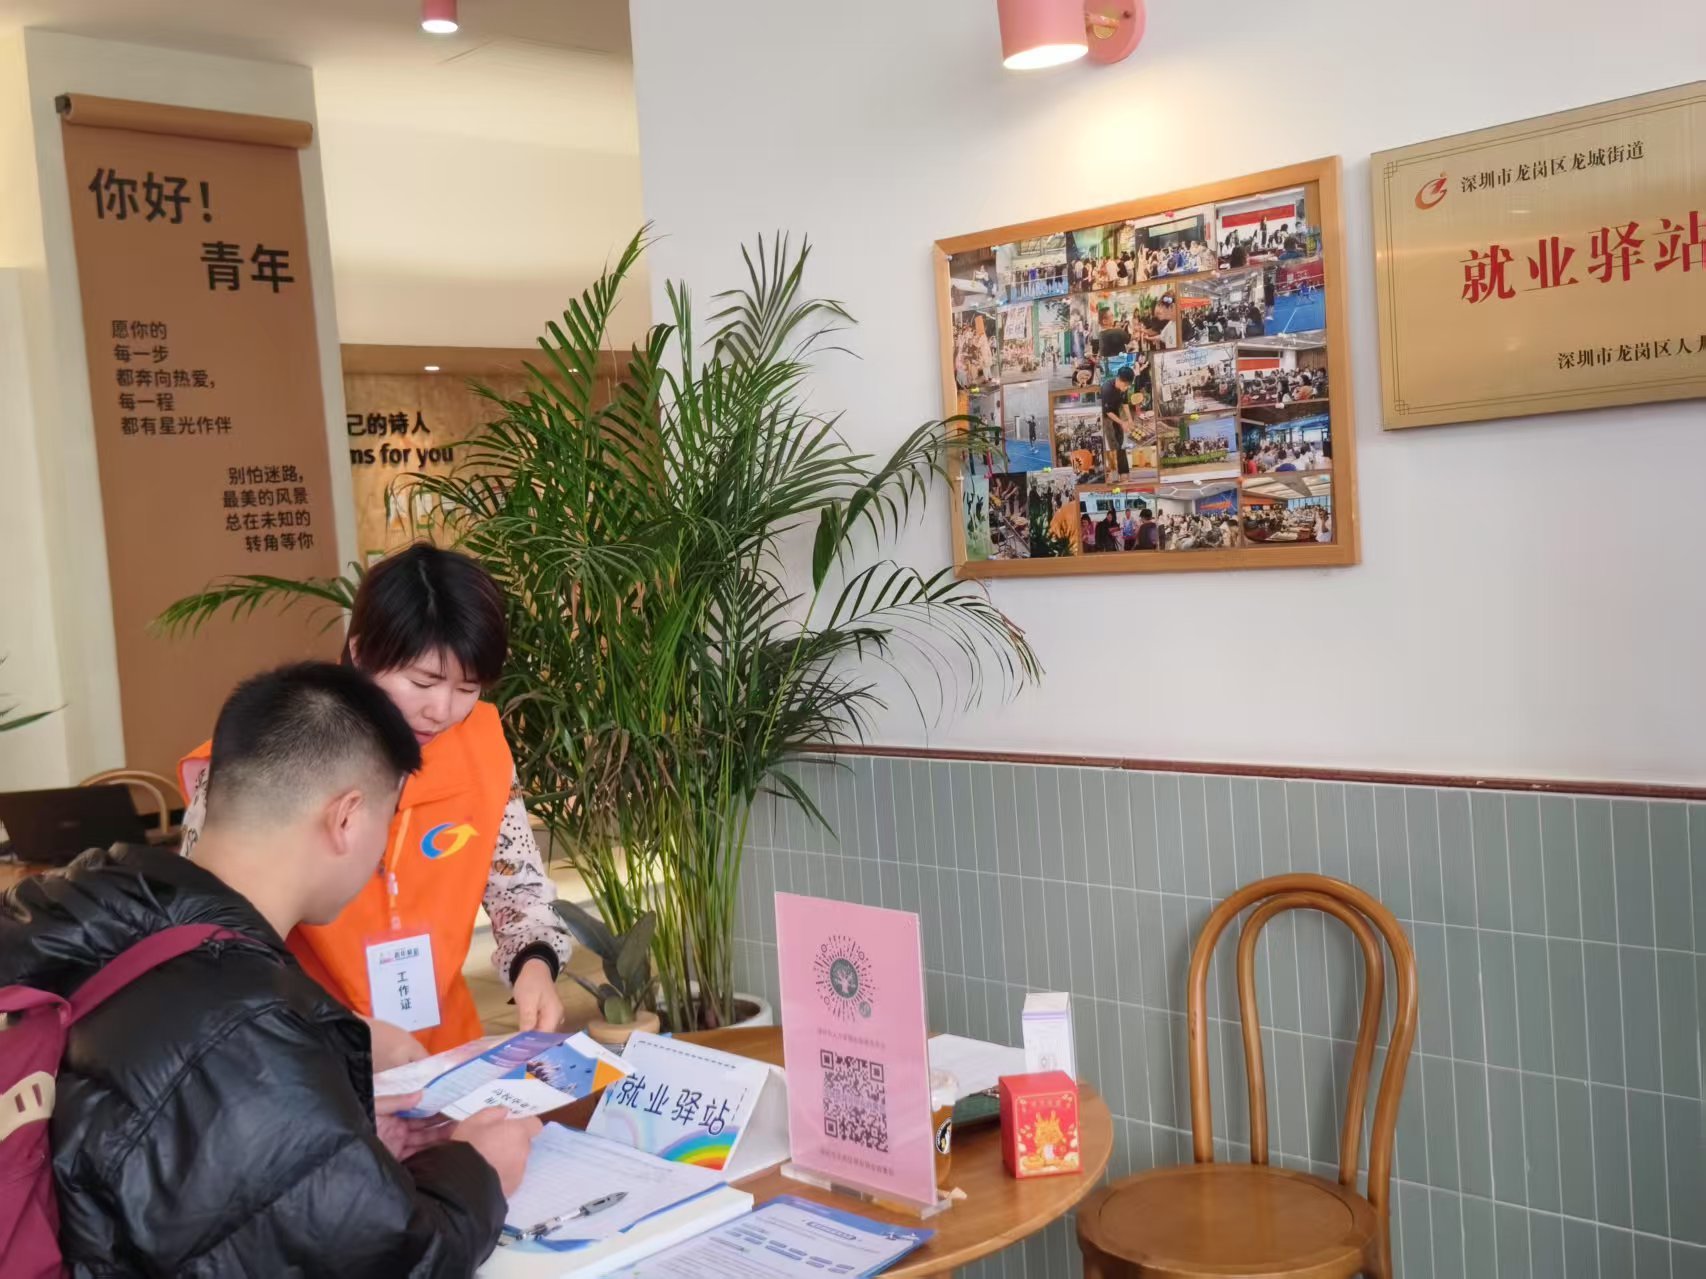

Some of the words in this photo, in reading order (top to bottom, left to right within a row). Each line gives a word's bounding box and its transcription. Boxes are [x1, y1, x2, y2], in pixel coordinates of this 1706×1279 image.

[1461, 140, 1645, 193] 深圳市龙岗区龙城街道
[200, 241, 294, 293] 青年
[1459, 210, 1706, 304] 就业驿站
[111, 320, 167, 341] 愿你的
[113, 344, 169, 364] 每一步
[119, 393, 175, 412] 每一程
[121, 415, 232, 436] 都有星光作伴
[380, 443, 411, 464] for
[416, 447, 453, 469] you
[222, 487, 308, 508] 最美的风景
[225, 509, 311, 532] 总在未知的
[245, 531, 314, 553] 转角等你
[397, 971, 412, 1010] 工作证
[616, 1072, 730, 1135] 就业驿站
